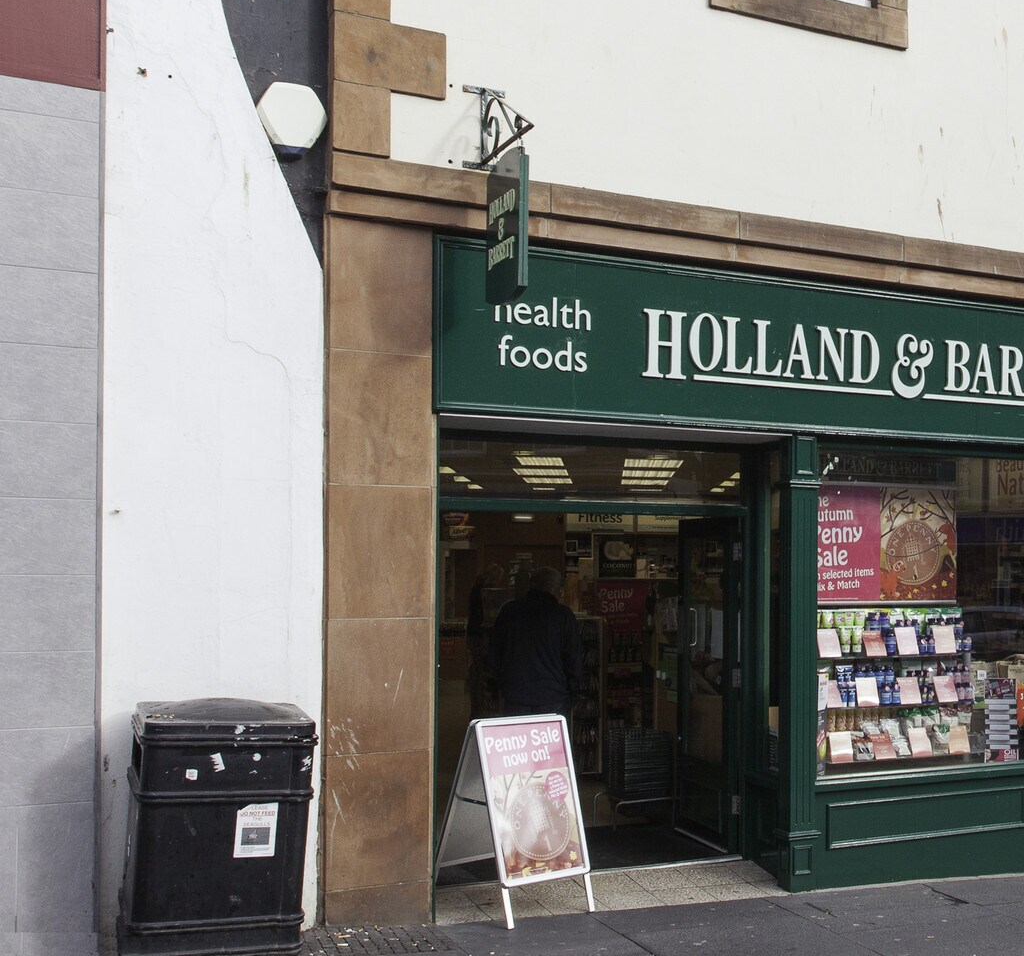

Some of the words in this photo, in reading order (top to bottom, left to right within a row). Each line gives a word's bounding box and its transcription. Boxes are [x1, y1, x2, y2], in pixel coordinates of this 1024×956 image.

[488, 188, 516, 225] HOLLAND
[487, 235, 515, 271] BARRETT
[498, 335, 588, 372] foods
[641, 307, 880, 385] HOLLAND
[890, 333, 934, 399] &
[817, 509, 853, 522] utumn
[822, 568, 853, 580] selected
[854, 567, 874, 578] items
[837, 579, 860, 590] Match
[599, 587, 634, 600] Penny
[601, 600, 625, 613] Sale
[484, 734, 527, 754] Penny
[530, 726, 560, 746] Sale
[502, 751, 528, 768] now
[531, 745, 551, 762] on!
